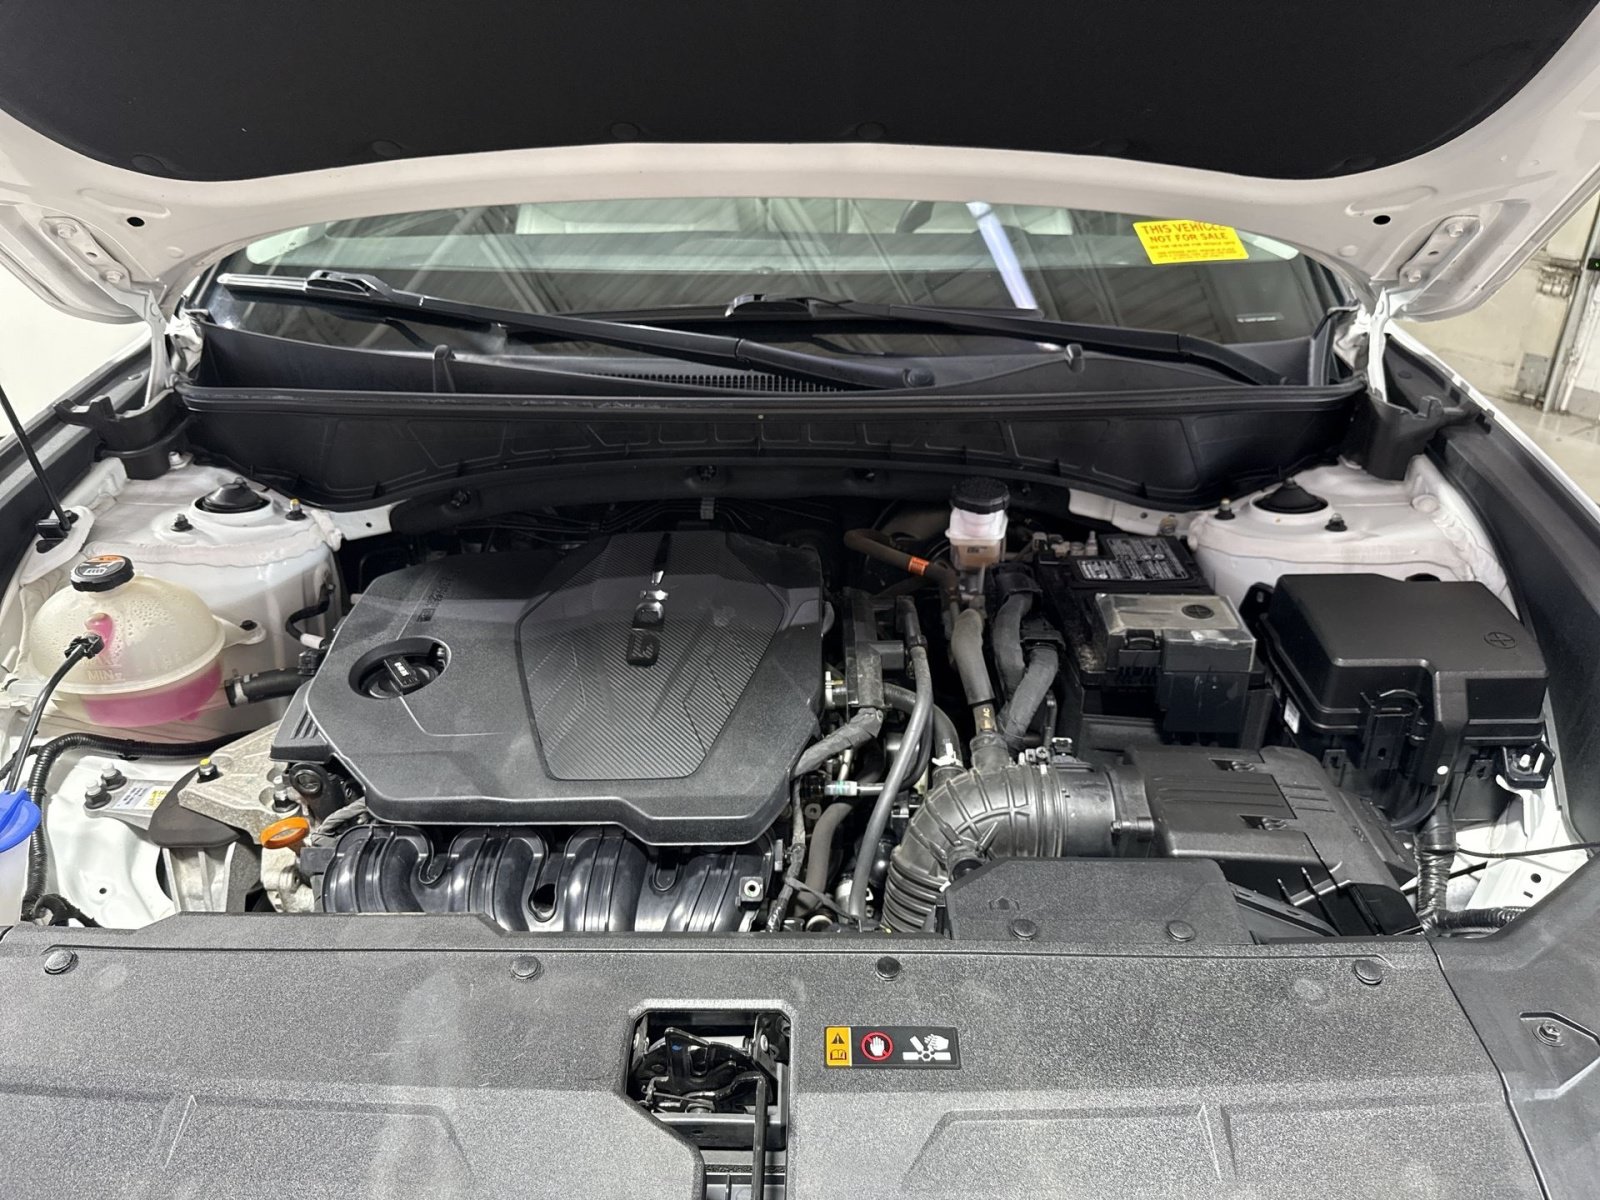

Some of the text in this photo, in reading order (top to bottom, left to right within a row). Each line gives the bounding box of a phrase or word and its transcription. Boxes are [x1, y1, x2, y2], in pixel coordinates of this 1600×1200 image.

[1141, 224, 1172, 235] THIS
[1150, 232, 1228, 244] NOT FOR SALE
